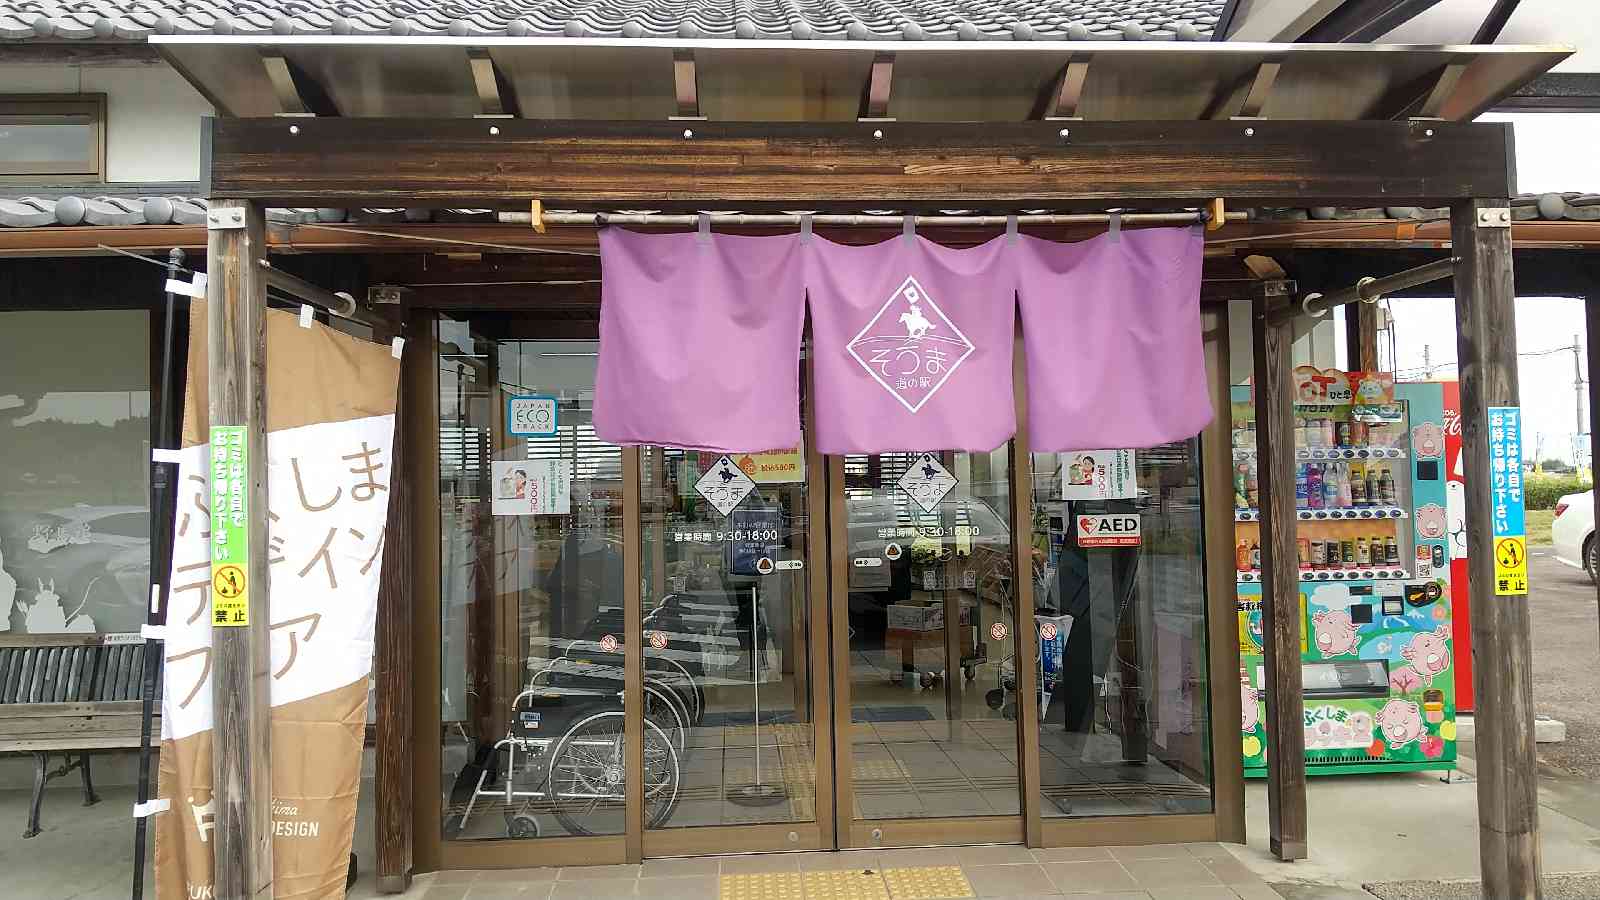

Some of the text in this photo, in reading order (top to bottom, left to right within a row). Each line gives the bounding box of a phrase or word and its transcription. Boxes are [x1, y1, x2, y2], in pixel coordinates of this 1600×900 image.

[870, 345, 948, 377] そうま
[896, 376, 931, 390] 道の駅
[516, 410, 550, 423] ECO
[1504, 412, 1521, 503] ゴミは各自で
[1491, 414, 1509, 534] お持ち帰り下さい
[1098, 518, 1137, 531] AED
[716, 530, 777, 541] 9:30-18:00
[1498, 580, 1525, 591] 禁止
[215, 610, 245, 622] 禁止
